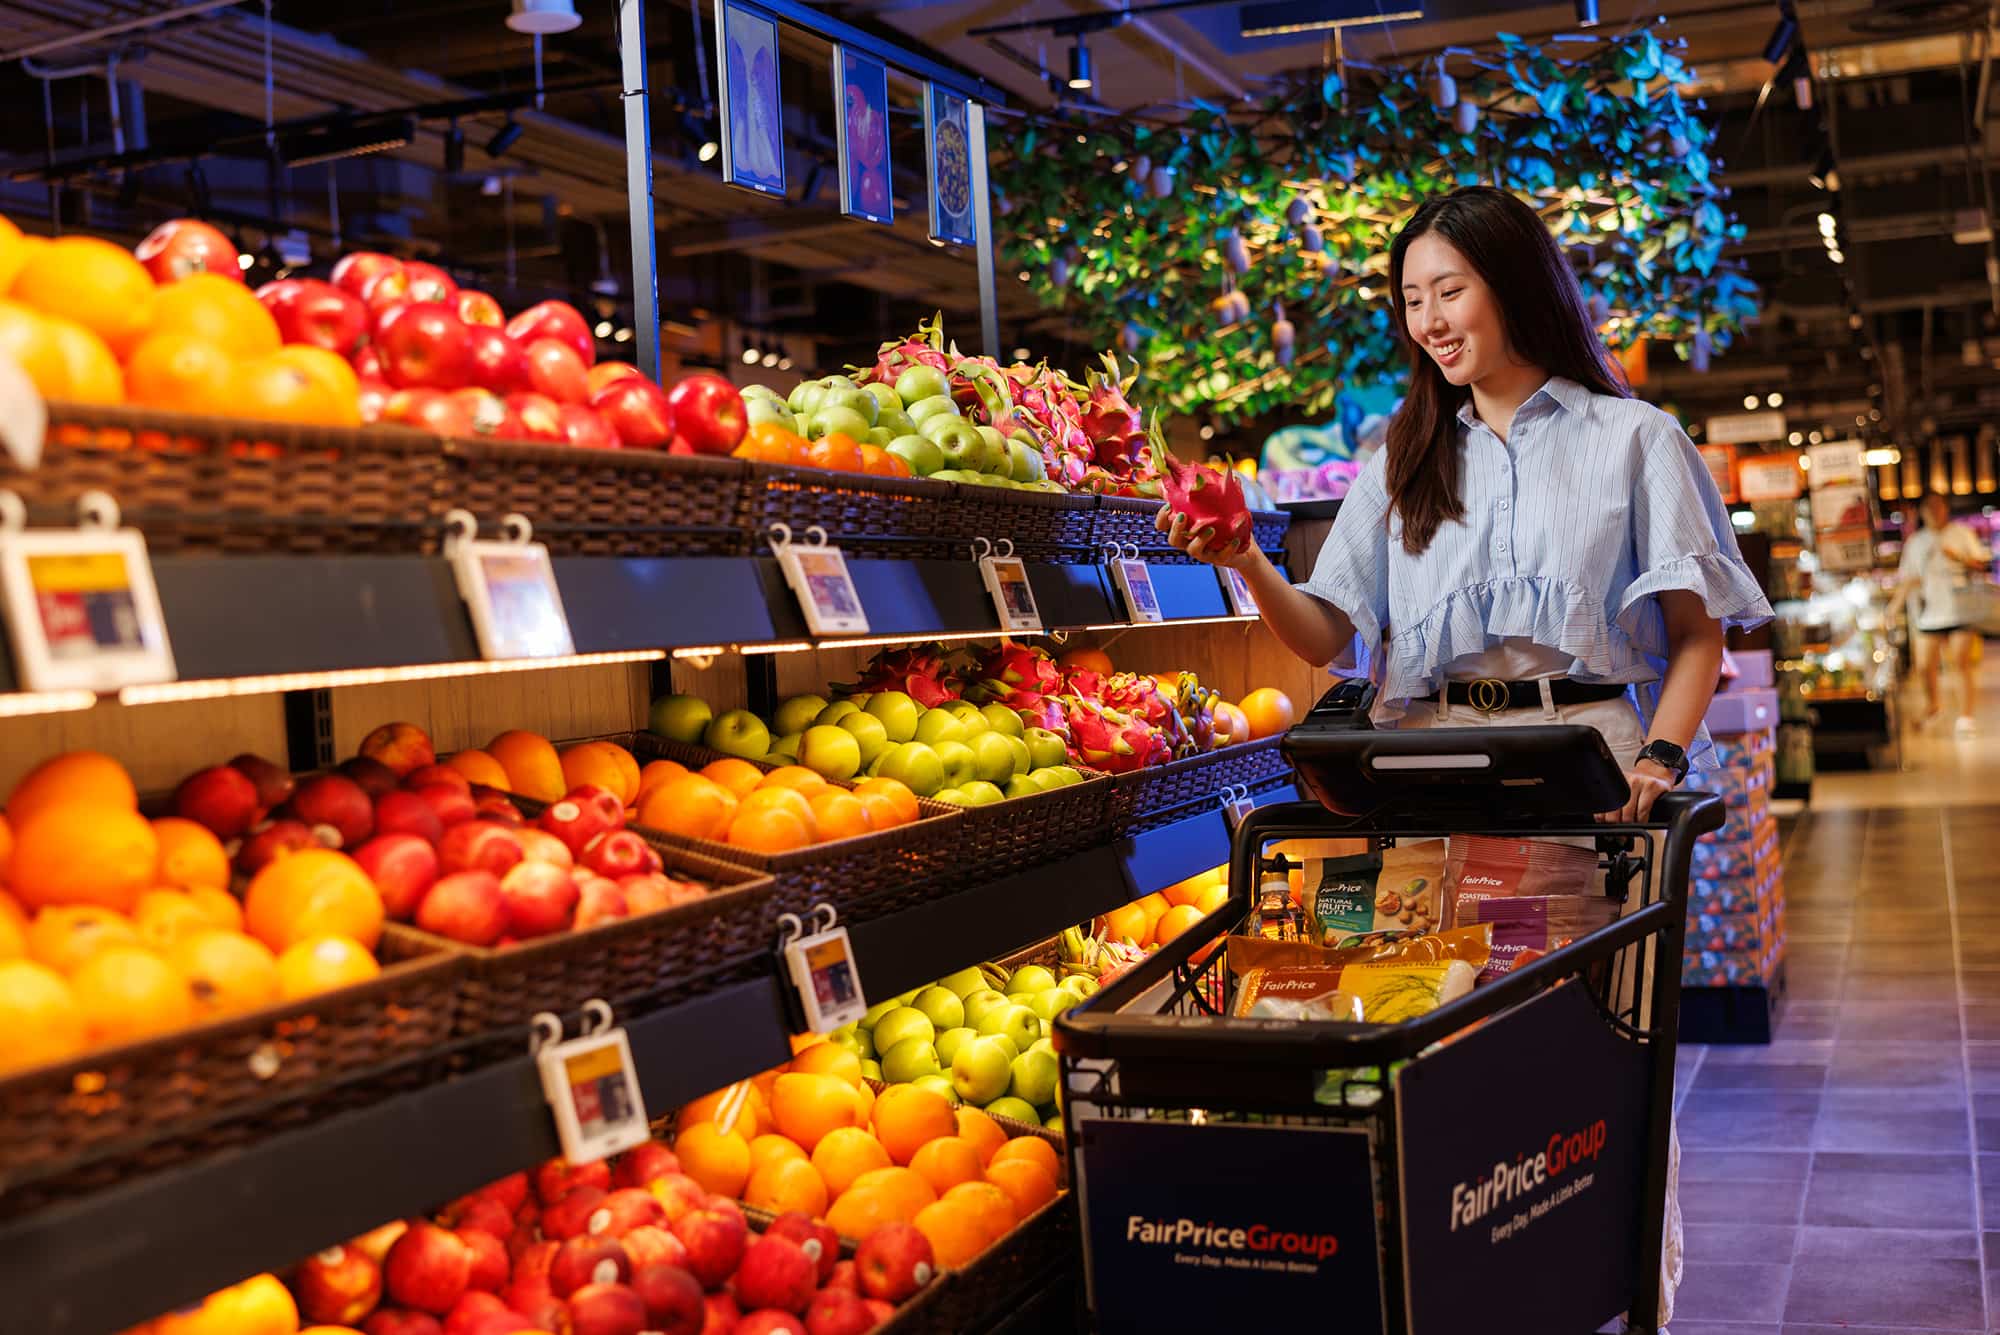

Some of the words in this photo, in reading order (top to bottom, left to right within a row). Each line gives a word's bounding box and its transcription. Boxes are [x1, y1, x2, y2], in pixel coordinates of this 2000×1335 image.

[1461, 875, 1503, 887] FairPrice
[1490, 944, 1528, 953] airPrice
[1262, 980, 1317, 992] FairPrice
[1450, 1119, 1607, 1233] FairPriceGroup
[1490, 1222, 1512, 1244] Every
[1530, 1200, 1549, 1221] Made
[1126, 1215, 1339, 1260] FairPriceGroup
